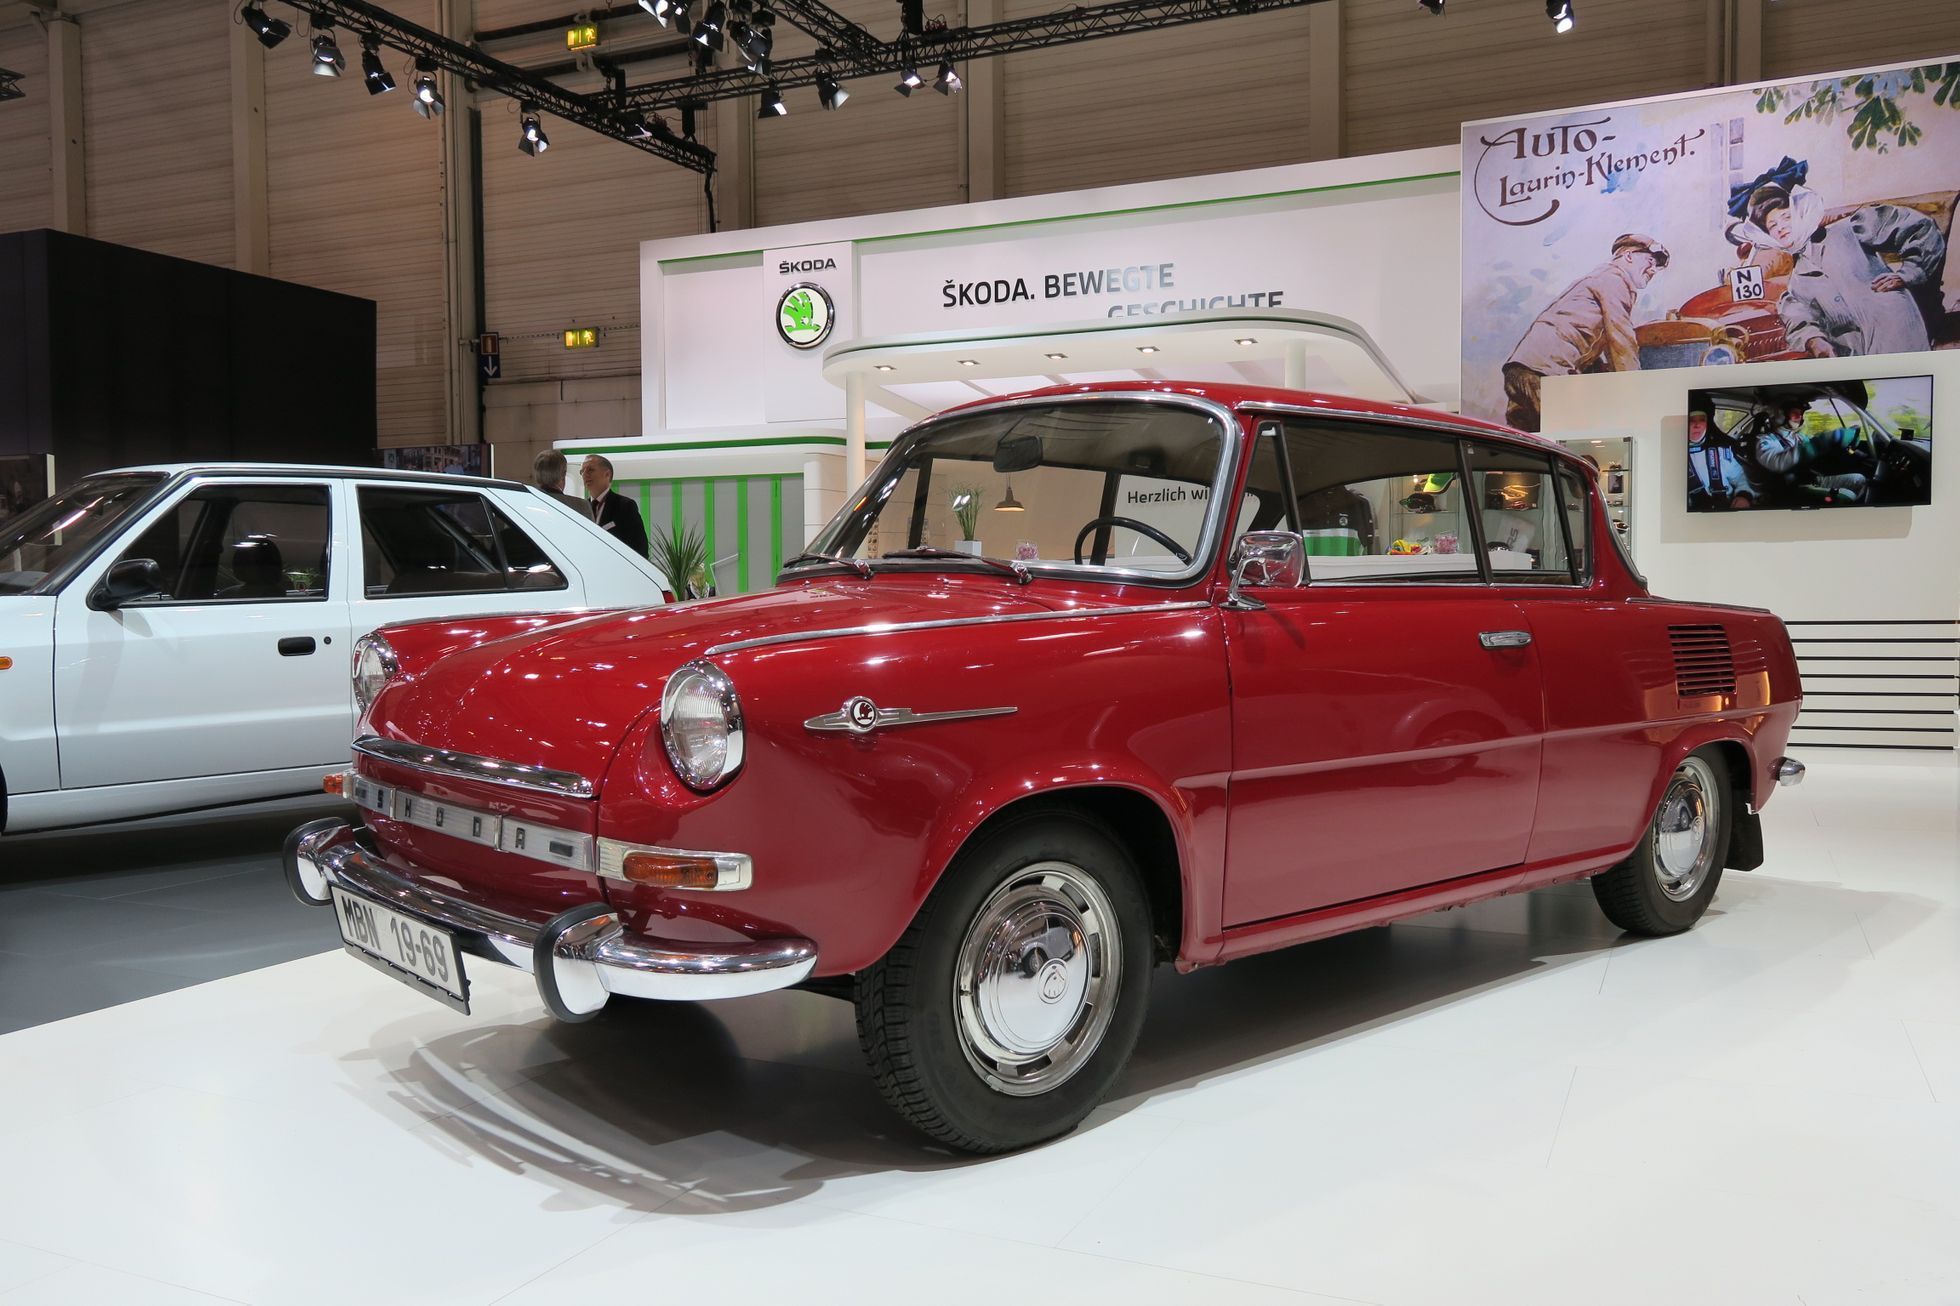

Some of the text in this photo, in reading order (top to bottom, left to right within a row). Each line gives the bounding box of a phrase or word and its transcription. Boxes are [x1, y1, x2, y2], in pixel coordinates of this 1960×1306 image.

[779, 258, 837, 274] ŠKODA
[942, 263, 1175, 308] ŠKODA. BEWEGTE
[1736, 270, 1752, 284] N
[1735, 283, 1762, 299] 130
[1127, 486, 1186, 504] Herzlich
[341, 895, 449, 983] MBN 19-69
